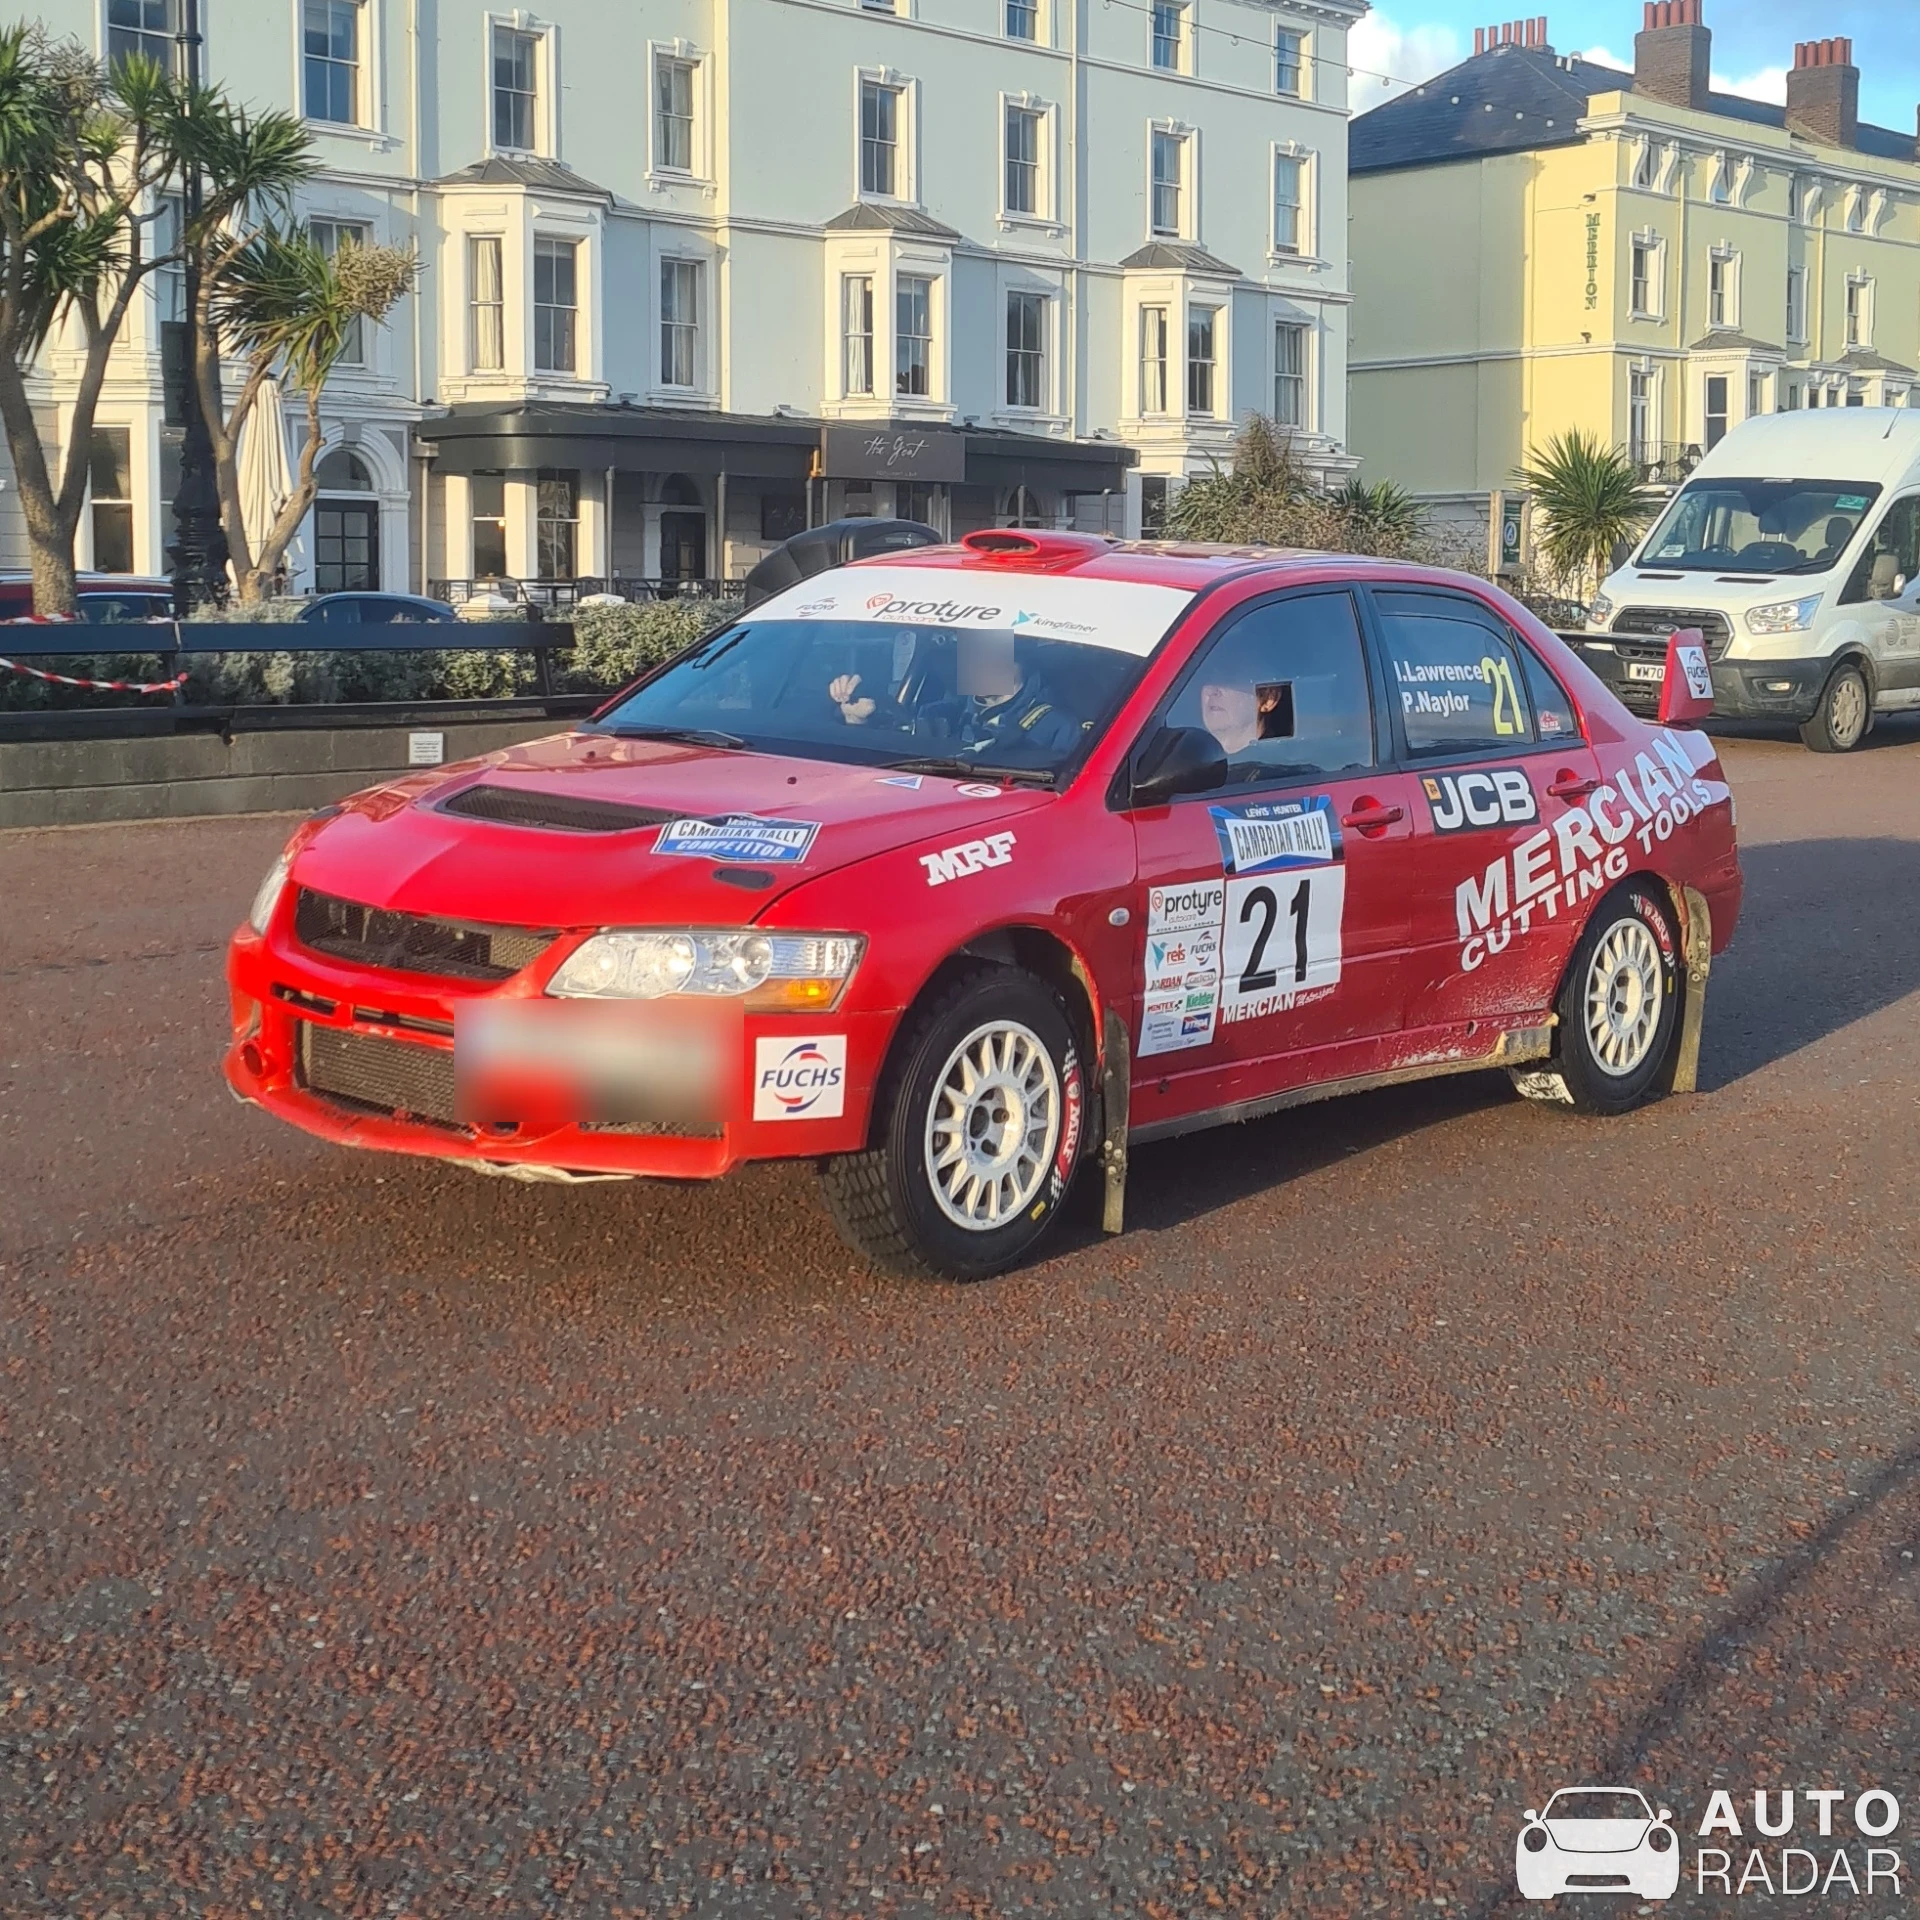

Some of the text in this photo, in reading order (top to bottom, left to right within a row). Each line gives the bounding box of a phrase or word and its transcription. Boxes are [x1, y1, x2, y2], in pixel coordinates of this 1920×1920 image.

[1585, 213, 1600, 310] MERRION
[874, 599, 1002, 623] protyre
[1033, 617, 1098, 634] kingfisher
[1393, 660, 1484, 682] I.Lawrence
[1687, 666, 1709, 679] FUCHS
[1401, 690, 1470, 718] P.Naylor
[1481, 656, 1525, 735] 21
[1245, 803, 1303, 818] LEWIS HUNTER
[1433, 771, 1536, 829] JCB
[678, 821, 753, 838] CAMBRIAN
[758, 829, 801, 843] RALLY
[1233, 816, 1327, 861] CAMBRIAN RALLY
[1455, 729, 1697, 942] MERCIAN
[676, 840, 786, 857] COMPETITOR
[919, 831, 1017, 887] MRF
[1461, 779, 1712, 972] CUTTING TOOLS
[1164, 889, 1222, 921] protyre
[1190, 941, 1217, 955] FUCHS
[1238, 878, 1311, 994] 21
[1222, 991, 1296, 1025] MERCIAN
[760, 1067, 842, 1088] FUCHS
